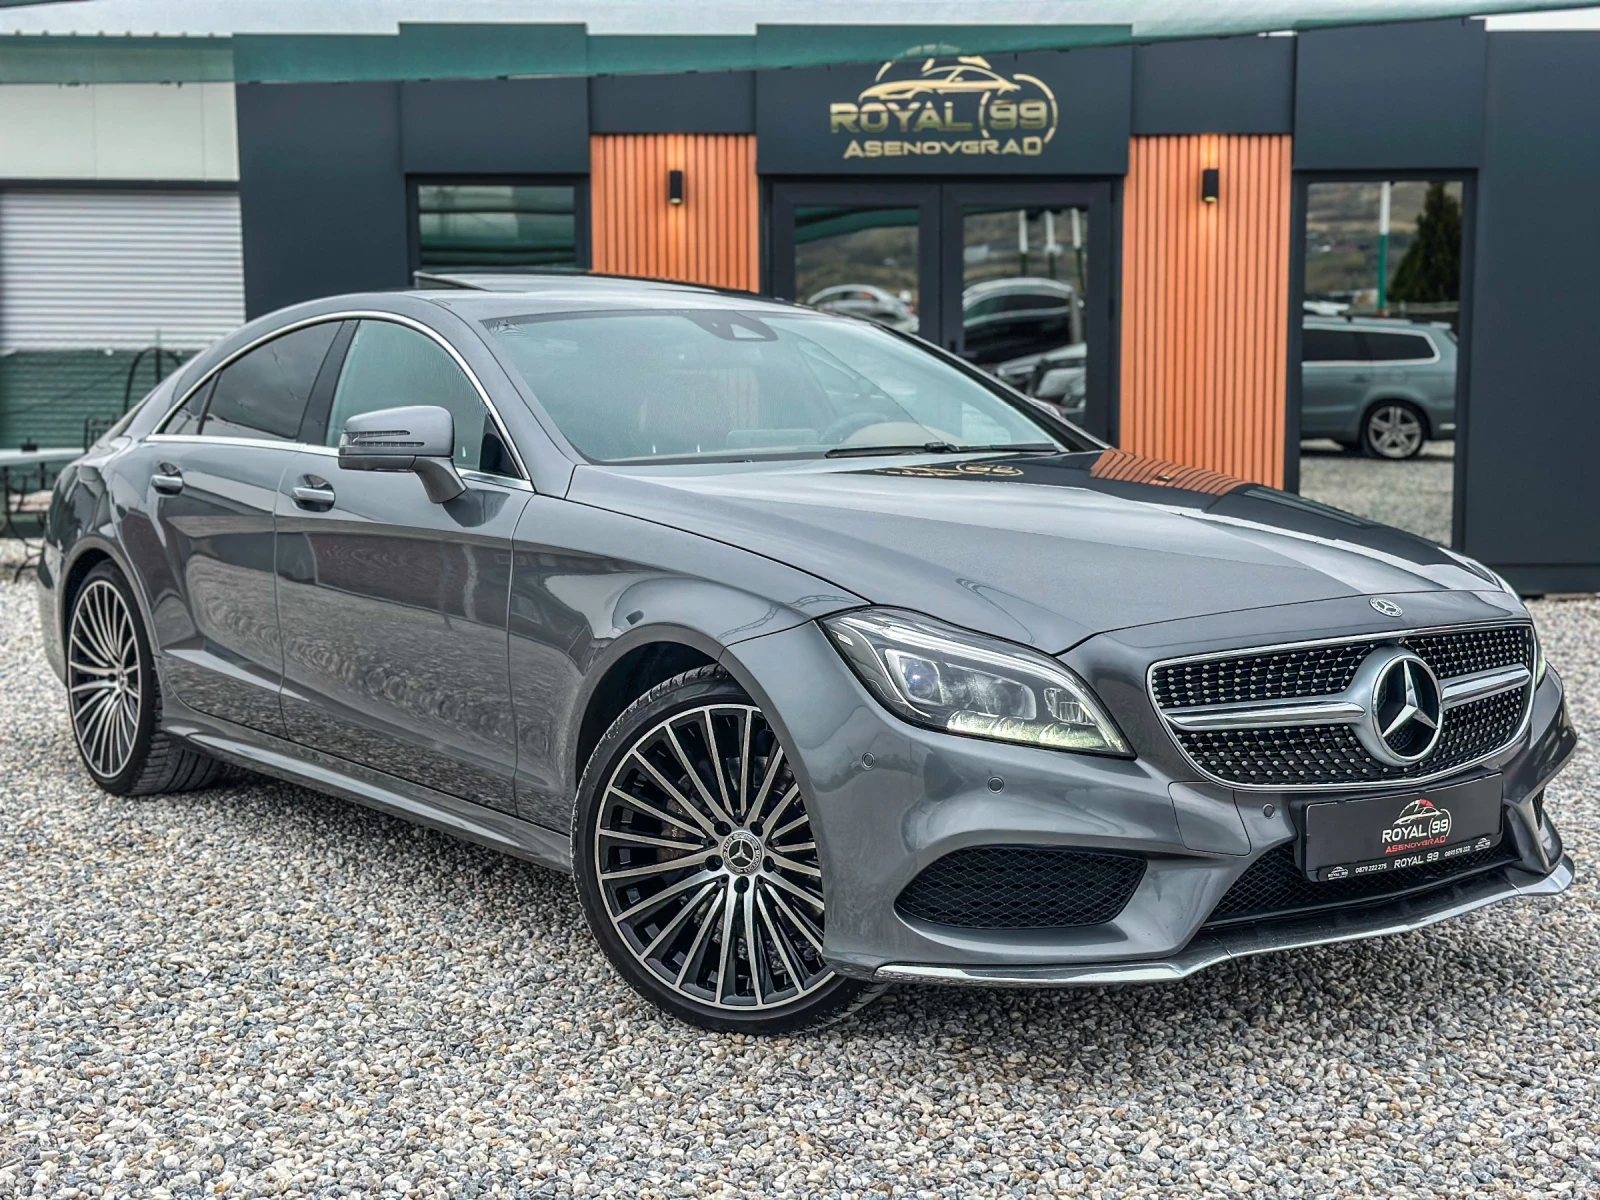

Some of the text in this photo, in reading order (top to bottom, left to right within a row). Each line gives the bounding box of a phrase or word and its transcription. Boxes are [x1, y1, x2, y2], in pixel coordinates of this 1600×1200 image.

[830, 100, 1048, 133] ROYAL 99
[843, 136, 1043, 159] ASENOVGRAD
[1381, 818, 1449, 844] ROYAL 99
[1385, 834, 1447, 854] ASENOVGRAD
[1368, 864, 1378, 872] 222
[1393, 851, 1439, 869] ROYAL 99
